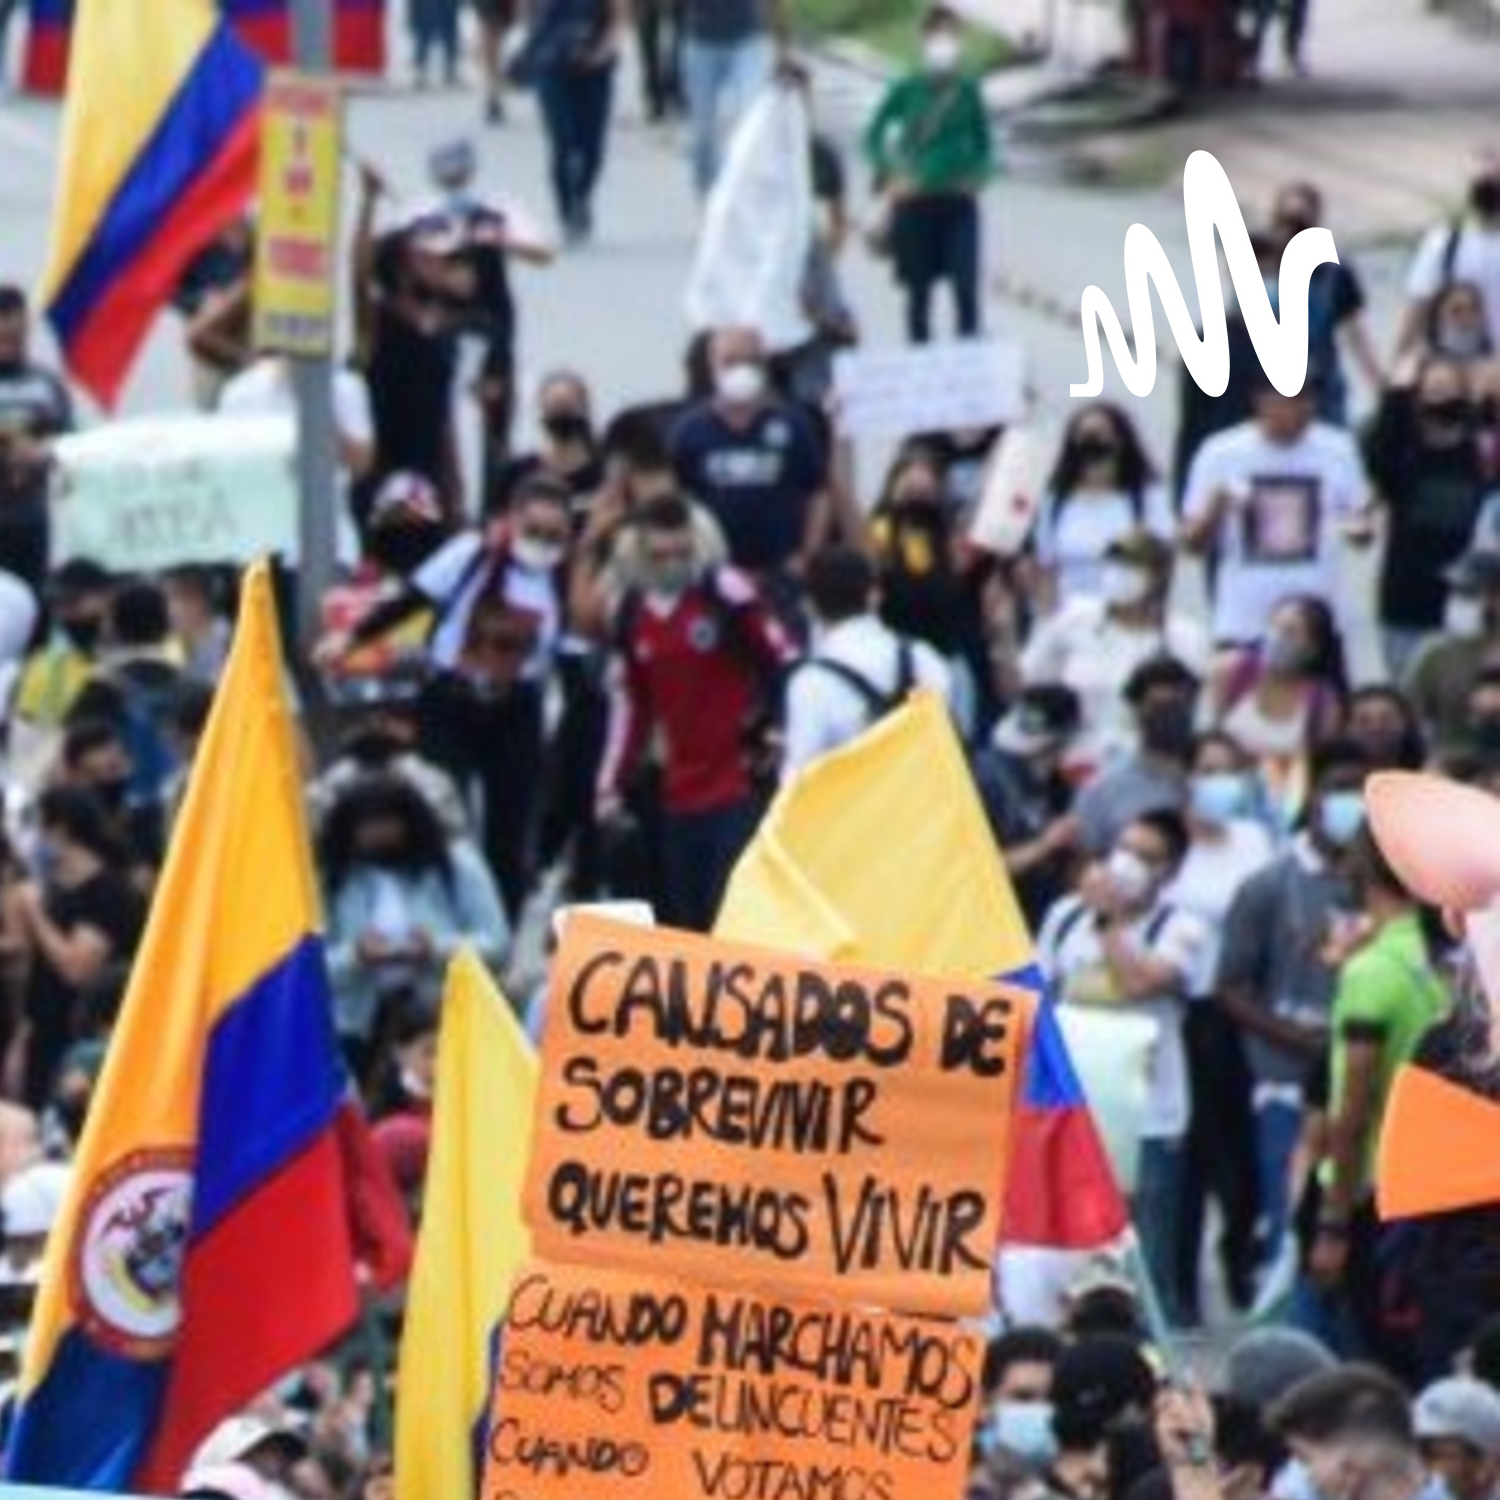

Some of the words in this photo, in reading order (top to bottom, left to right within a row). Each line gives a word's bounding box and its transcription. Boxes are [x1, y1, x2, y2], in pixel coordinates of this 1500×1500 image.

[569, 951, 914, 1067] CANSADOS
[940, 995, 1011, 1077] DE
[555, 1056, 886, 1156] SOBREVIVIR
[547, 1160, 810, 1260] QUEREMOS
[822, 1171, 993, 1276] VIVIR
[504, 1274, 688, 1346] CUANDO
[697, 1293, 975, 1409] MARCHAMOS
[487, 1417, 650, 1477] CUANDO
[499, 1349, 626, 1414] SOMOS
[648, 1371, 958, 1464] DELINCUENTES
